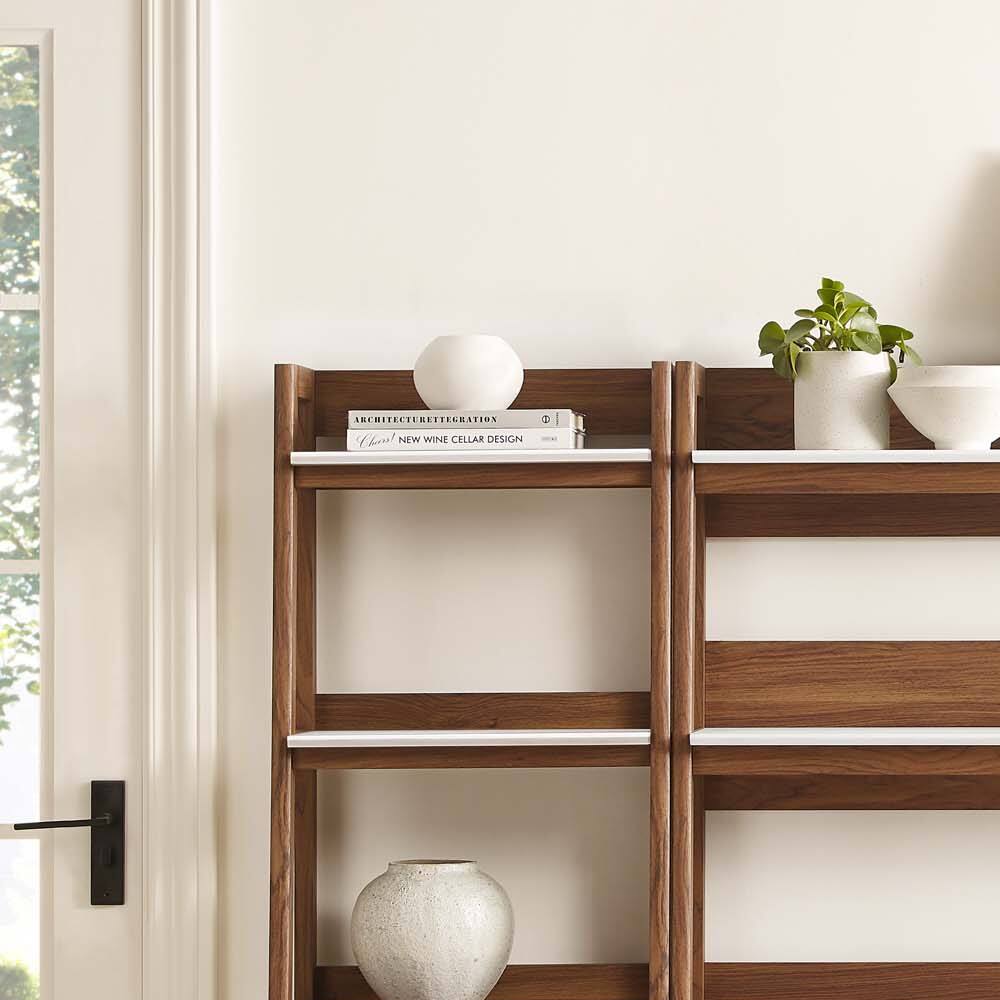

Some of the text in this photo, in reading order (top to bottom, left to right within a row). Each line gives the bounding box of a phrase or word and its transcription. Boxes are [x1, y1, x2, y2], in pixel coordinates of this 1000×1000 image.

[353, 415, 498, 424] ARCHITECTURETTEGRATION
[398, 435, 421, 444] NEW
[424, 435, 449, 444] WINE
[451, 435, 485, 444] CELLAR
[487, 434, 523, 444] DESIGN
